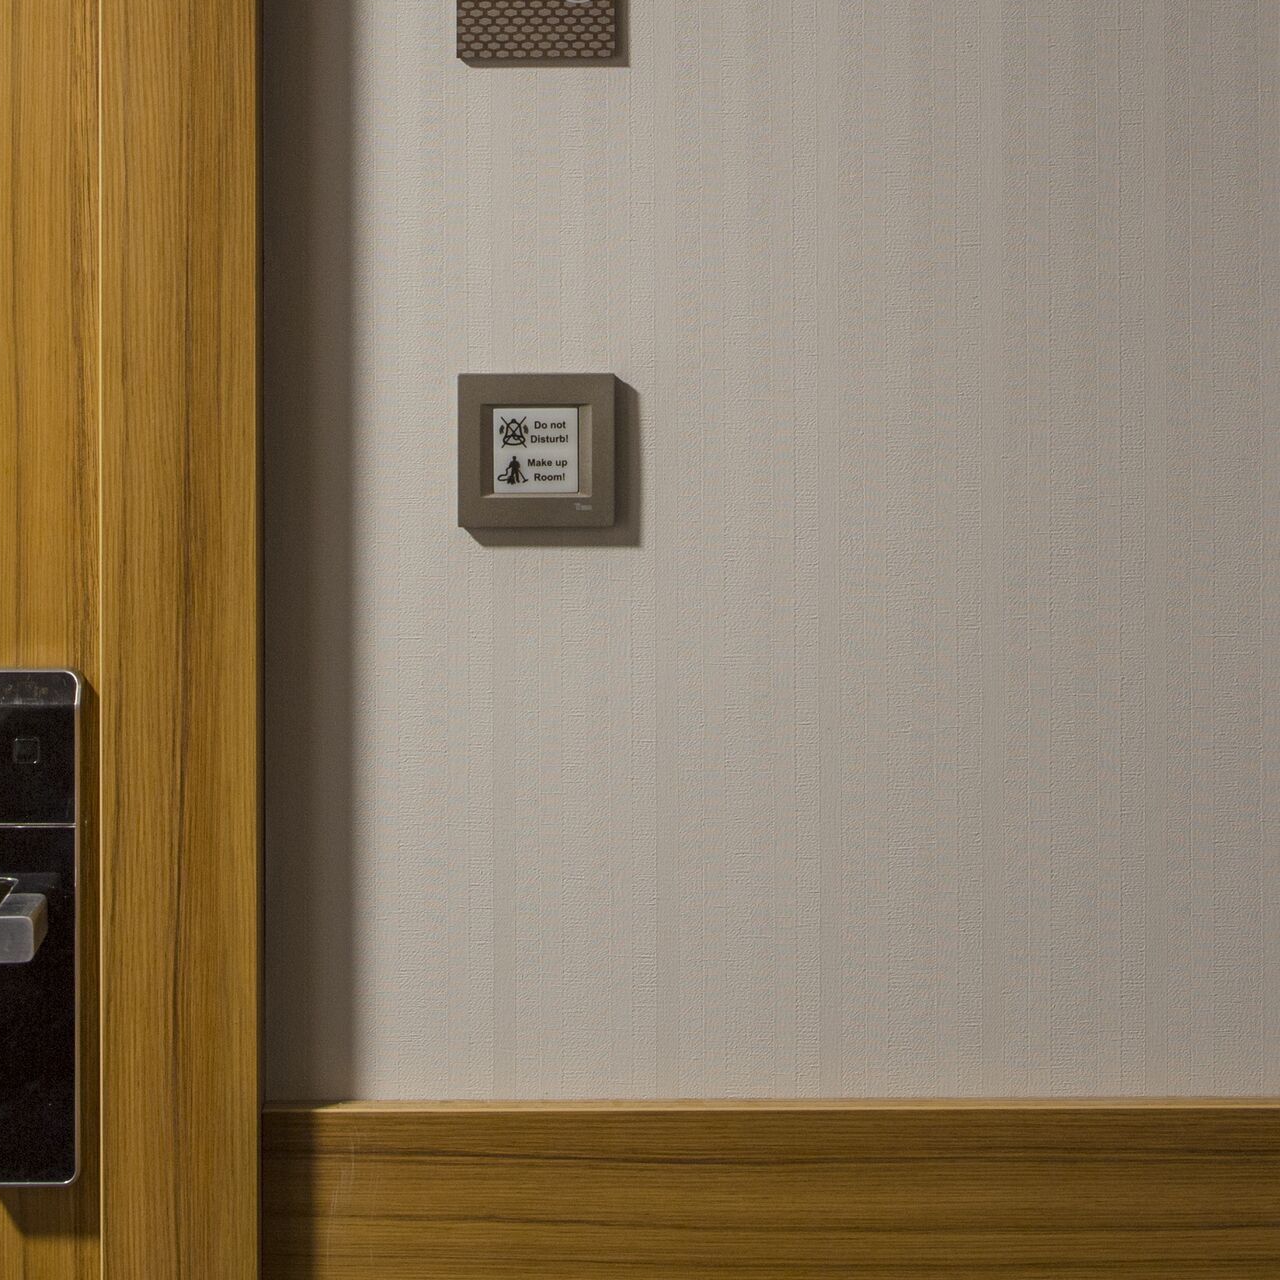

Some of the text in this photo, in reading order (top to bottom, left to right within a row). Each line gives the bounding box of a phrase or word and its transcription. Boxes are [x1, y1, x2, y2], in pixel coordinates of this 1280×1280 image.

[533, 420, 567, 430] Do not
[530, 434, 569, 444] Disturb!
[527, 458, 568, 469] Make up
[533, 472, 566, 482] Room!
